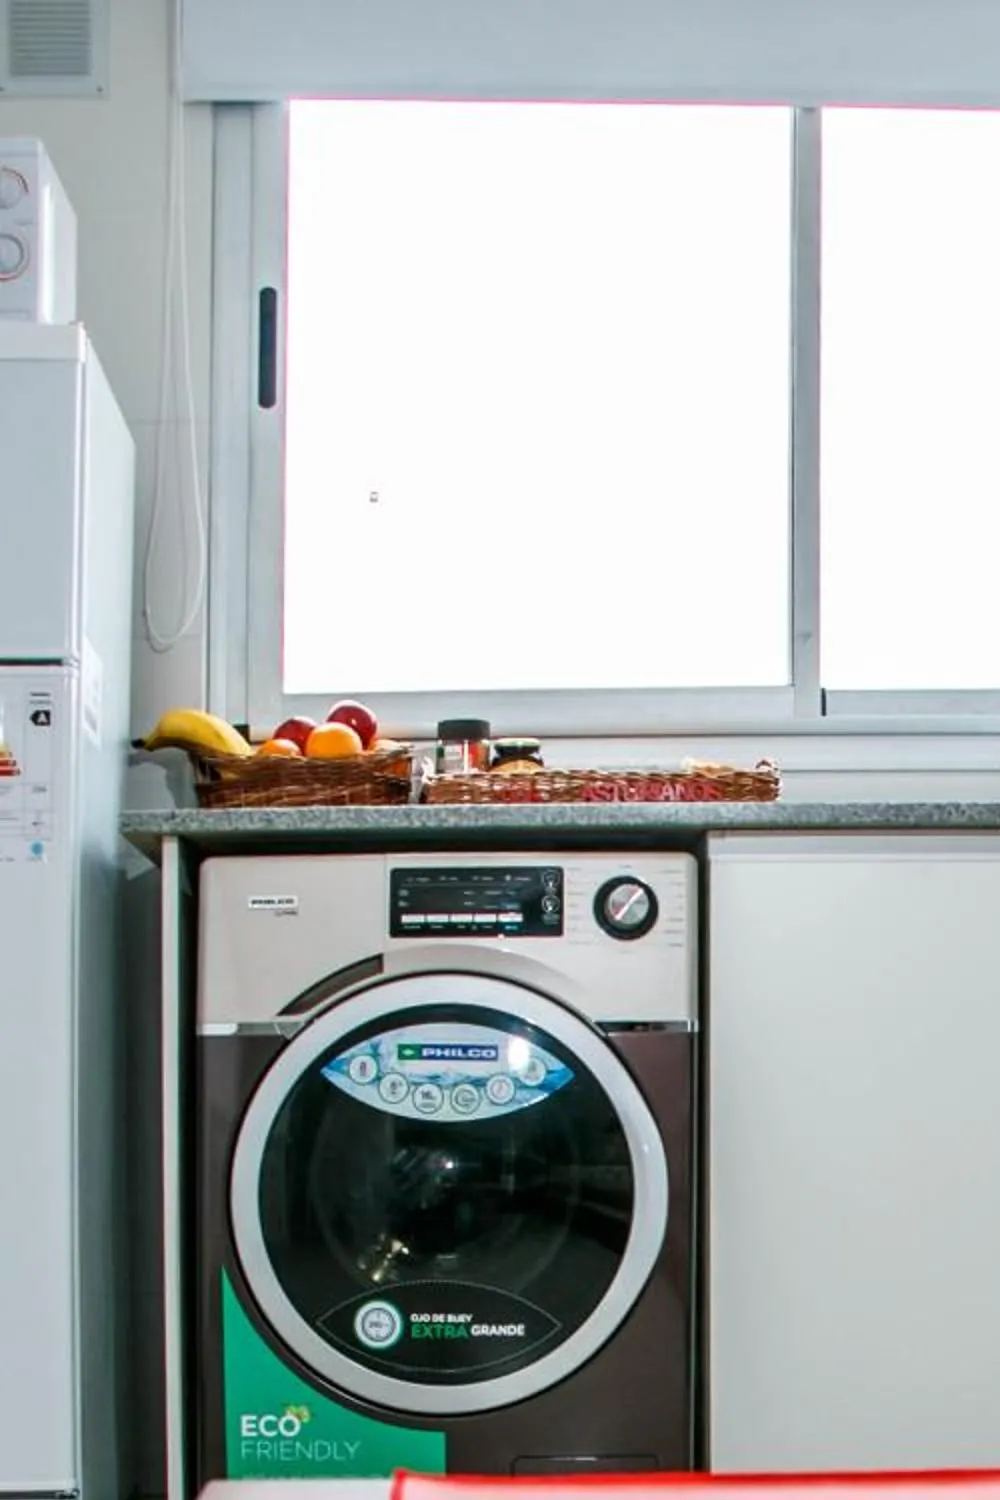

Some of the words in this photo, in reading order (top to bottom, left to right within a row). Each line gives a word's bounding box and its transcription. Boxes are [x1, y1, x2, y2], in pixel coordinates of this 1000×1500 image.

[421, 1047, 497, 1058] PHILCO
[431, 1313, 446, 1323] DE
[410, 1324, 469, 1339] EXTRA
[470, 1323, 525, 1337] GRANDE
[240, 1414, 301, 1437] ECO
[241, 1440, 361, 1461] FRIENDLY
